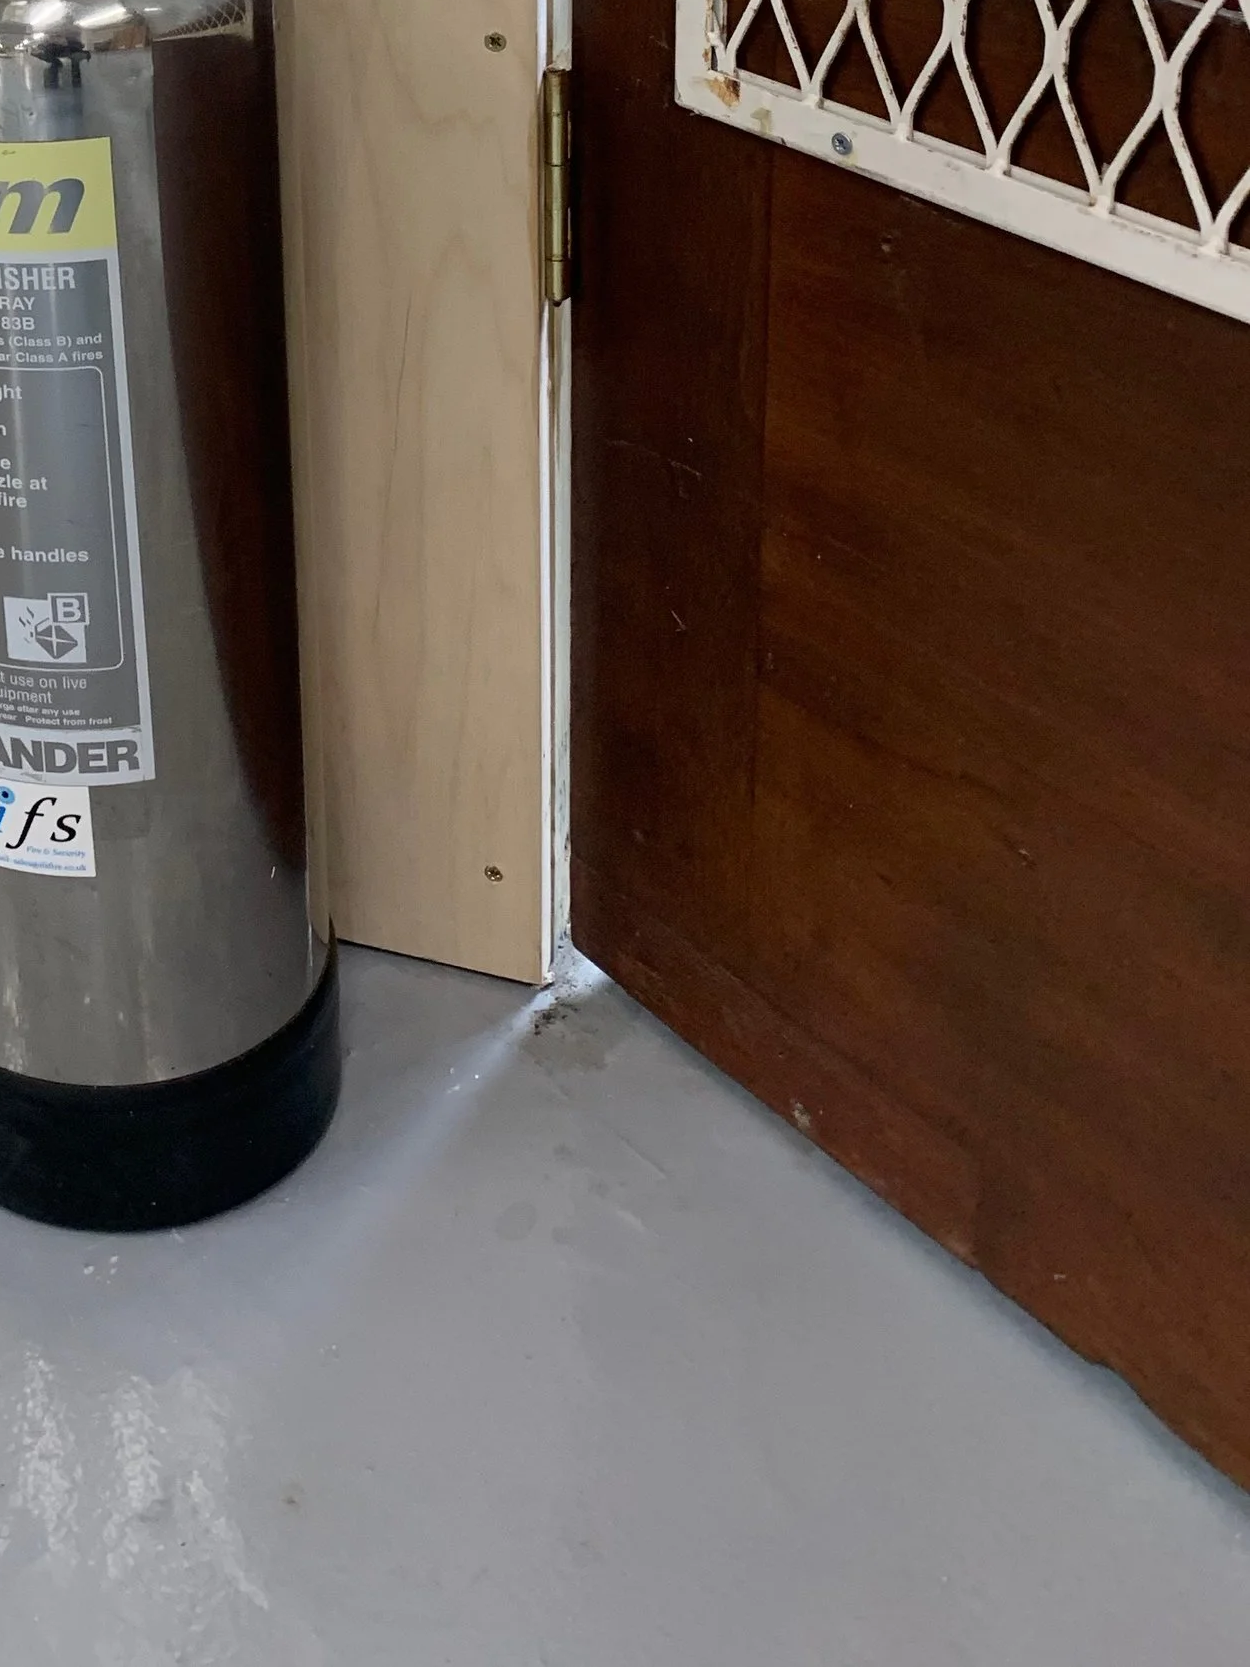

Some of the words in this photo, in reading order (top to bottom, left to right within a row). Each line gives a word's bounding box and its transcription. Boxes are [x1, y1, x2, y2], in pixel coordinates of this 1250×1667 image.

[8, 335, 52, 348] (Class
[56, 335, 71, 348] B)
[76, 332, 102, 345] and
[15, 351, 54, 363] Class
[57, 352, 68, 362] A
[72, 350, 103, 362] fires
[29, 477, 48, 491] at
[10, 546, 89, 563] handles
[56, 597, 81, 623] B
[9, 674, 35, 687] use
[39, 677, 58, 689] on
[62, 675, 87, 689] live
[25, 715, 60, 726] Protect
[63, 717, 86, 726] from
[88, 717, 112, 726] frost
